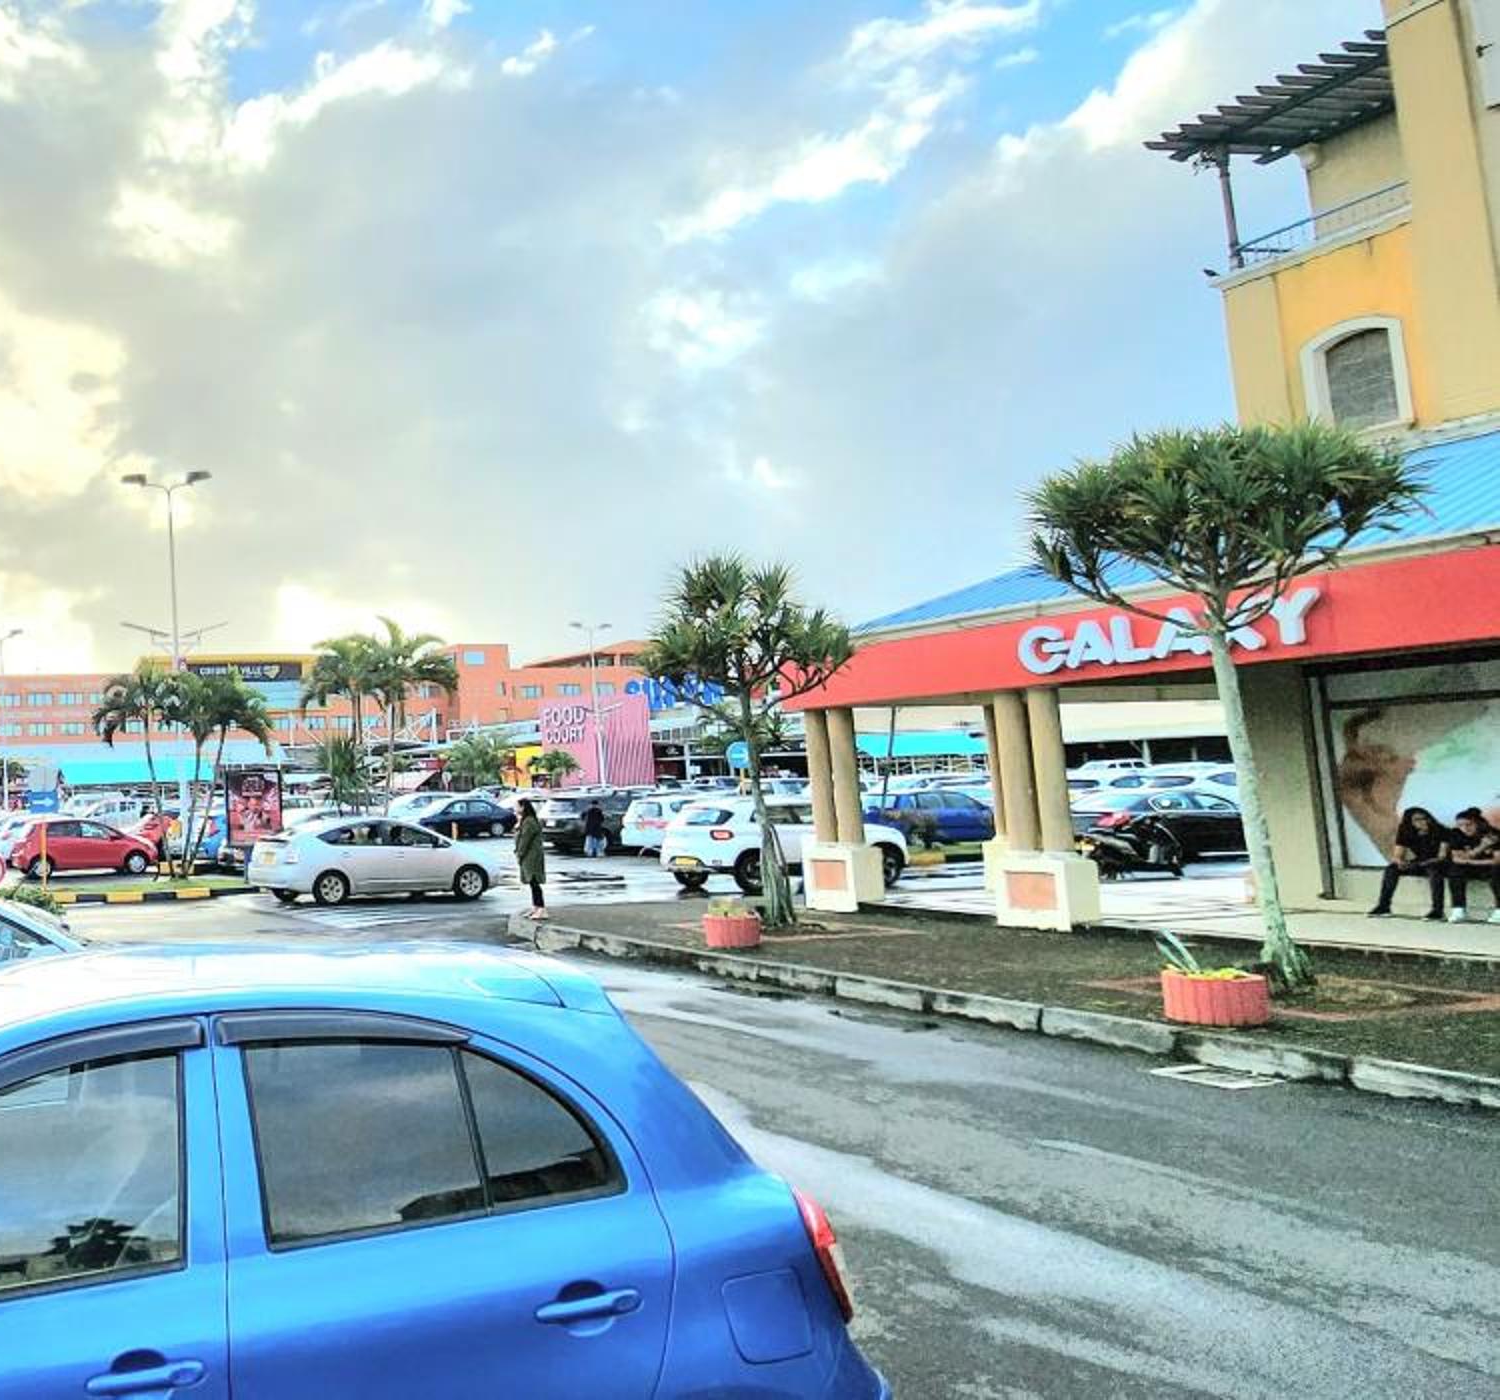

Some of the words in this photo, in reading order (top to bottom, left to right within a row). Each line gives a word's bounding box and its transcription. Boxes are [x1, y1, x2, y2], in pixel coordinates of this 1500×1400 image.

[1017, 587, 1320, 674] GALAXY
[543, 705, 586, 726] FOOD
[546, 725, 584, 743] COURT
